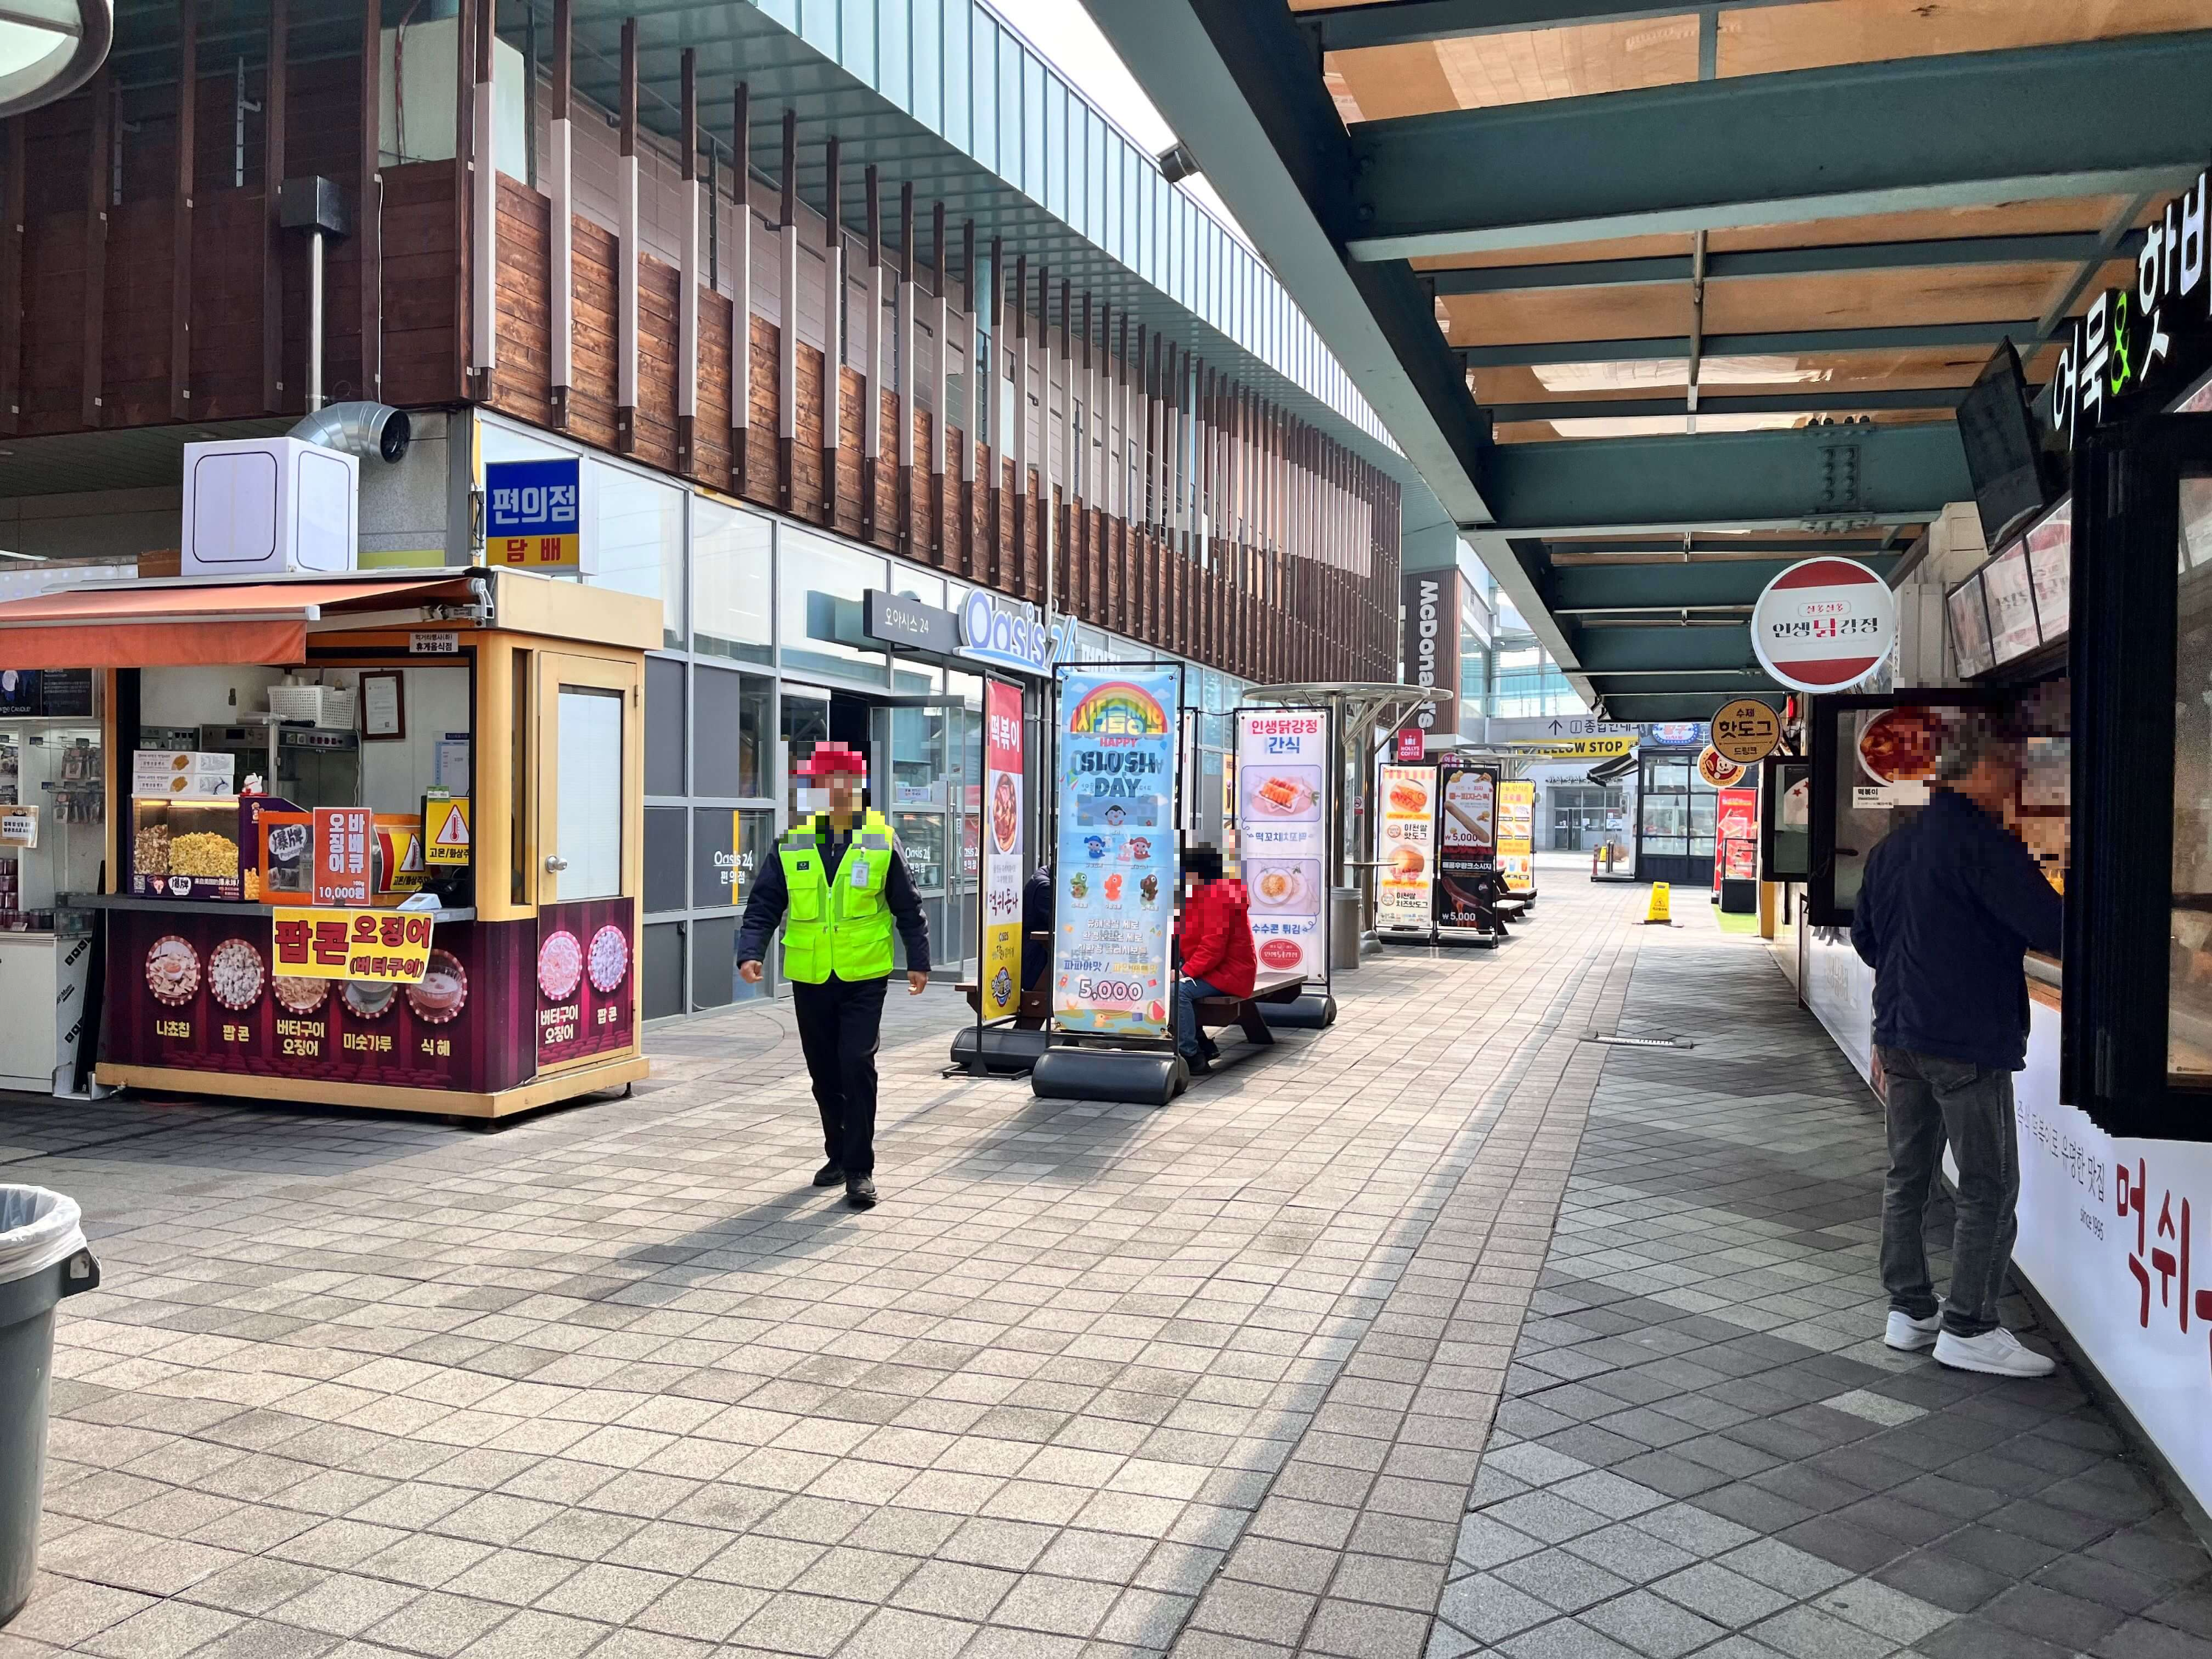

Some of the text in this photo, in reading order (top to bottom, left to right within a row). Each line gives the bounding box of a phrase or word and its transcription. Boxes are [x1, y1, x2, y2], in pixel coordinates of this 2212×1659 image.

[493, 484, 576, 525] 편의점
[885, 607, 930, 634] 오아시스 24
[967, 588, 1046, 668] Oasis
[1773, 617, 1879, 639] 인생닭강정
[416, 642, 452, 652] 휴게음식점
[1418, 580, 1439, 728] McDonad's
[1736, 709, 1755, 717] 수제
[991, 714, 1020, 752] 떡볶이
[1252, 720, 1318, 734] 인생닭강정
[1719, 720, 1773, 739] 핫도그
[1099, 737, 1138, 747] HAPPY
[1268, 737, 1300, 754] 간식
[1590, 741, 1623, 752] STOP
[1734, 747, 1757, 755] 드링크
[1081, 751, 1155, 773] SLUSH
[1095, 777, 1141, 798] DAY
[1256, 832, 1281, 841] 떡꼬치
[1405, 824, 1427, 832] 이천쌀
[329, 813, 344, 874] 오징어
[348, 813, 366, 874] 바베큐
[430, 848, 470, 858] 고온/화상주
[714, 849, 753, 870] Oasis 24
[905, 846, 931, 862] Oasis 24
[720, 871, 745, 884] 편의점
[319, 886, 365, 900] 10,000원
[990, 888, 1018, 916] 먹쉬돈나
[1396, 900, 1428, 908] 치즈핫도그
[351, 916, 431, 948] 오징어
[1283, 924, 1300, 934] 튀김
[349, 956, 424, 978] (버터구이)
[1064, 960, 1102, 971] 파파야맛
[1079, 978, 1144, 1001] 5,000
[540, 1004, 578, 1026] 버터구이
[156, 1020, 190, 1037] 나초칩
[276, 1019, 325, 1037] 버터구이
[544, 1023, 574, 1044] 오징어
[282, 1038, 319, 1057] 오징어
[343, 1033, 392, 1051] 미숫가루
[2032, 1112, 2059, 1158] 떡볶이로
[2061, 1135, 2085, 1186] 유명한
[2087, 1155, 2104, 1203] 맛집
[2080, 1205, 2104, 1241] since 1995
[2116, 1157, 2212, 1379] 먹쉬
